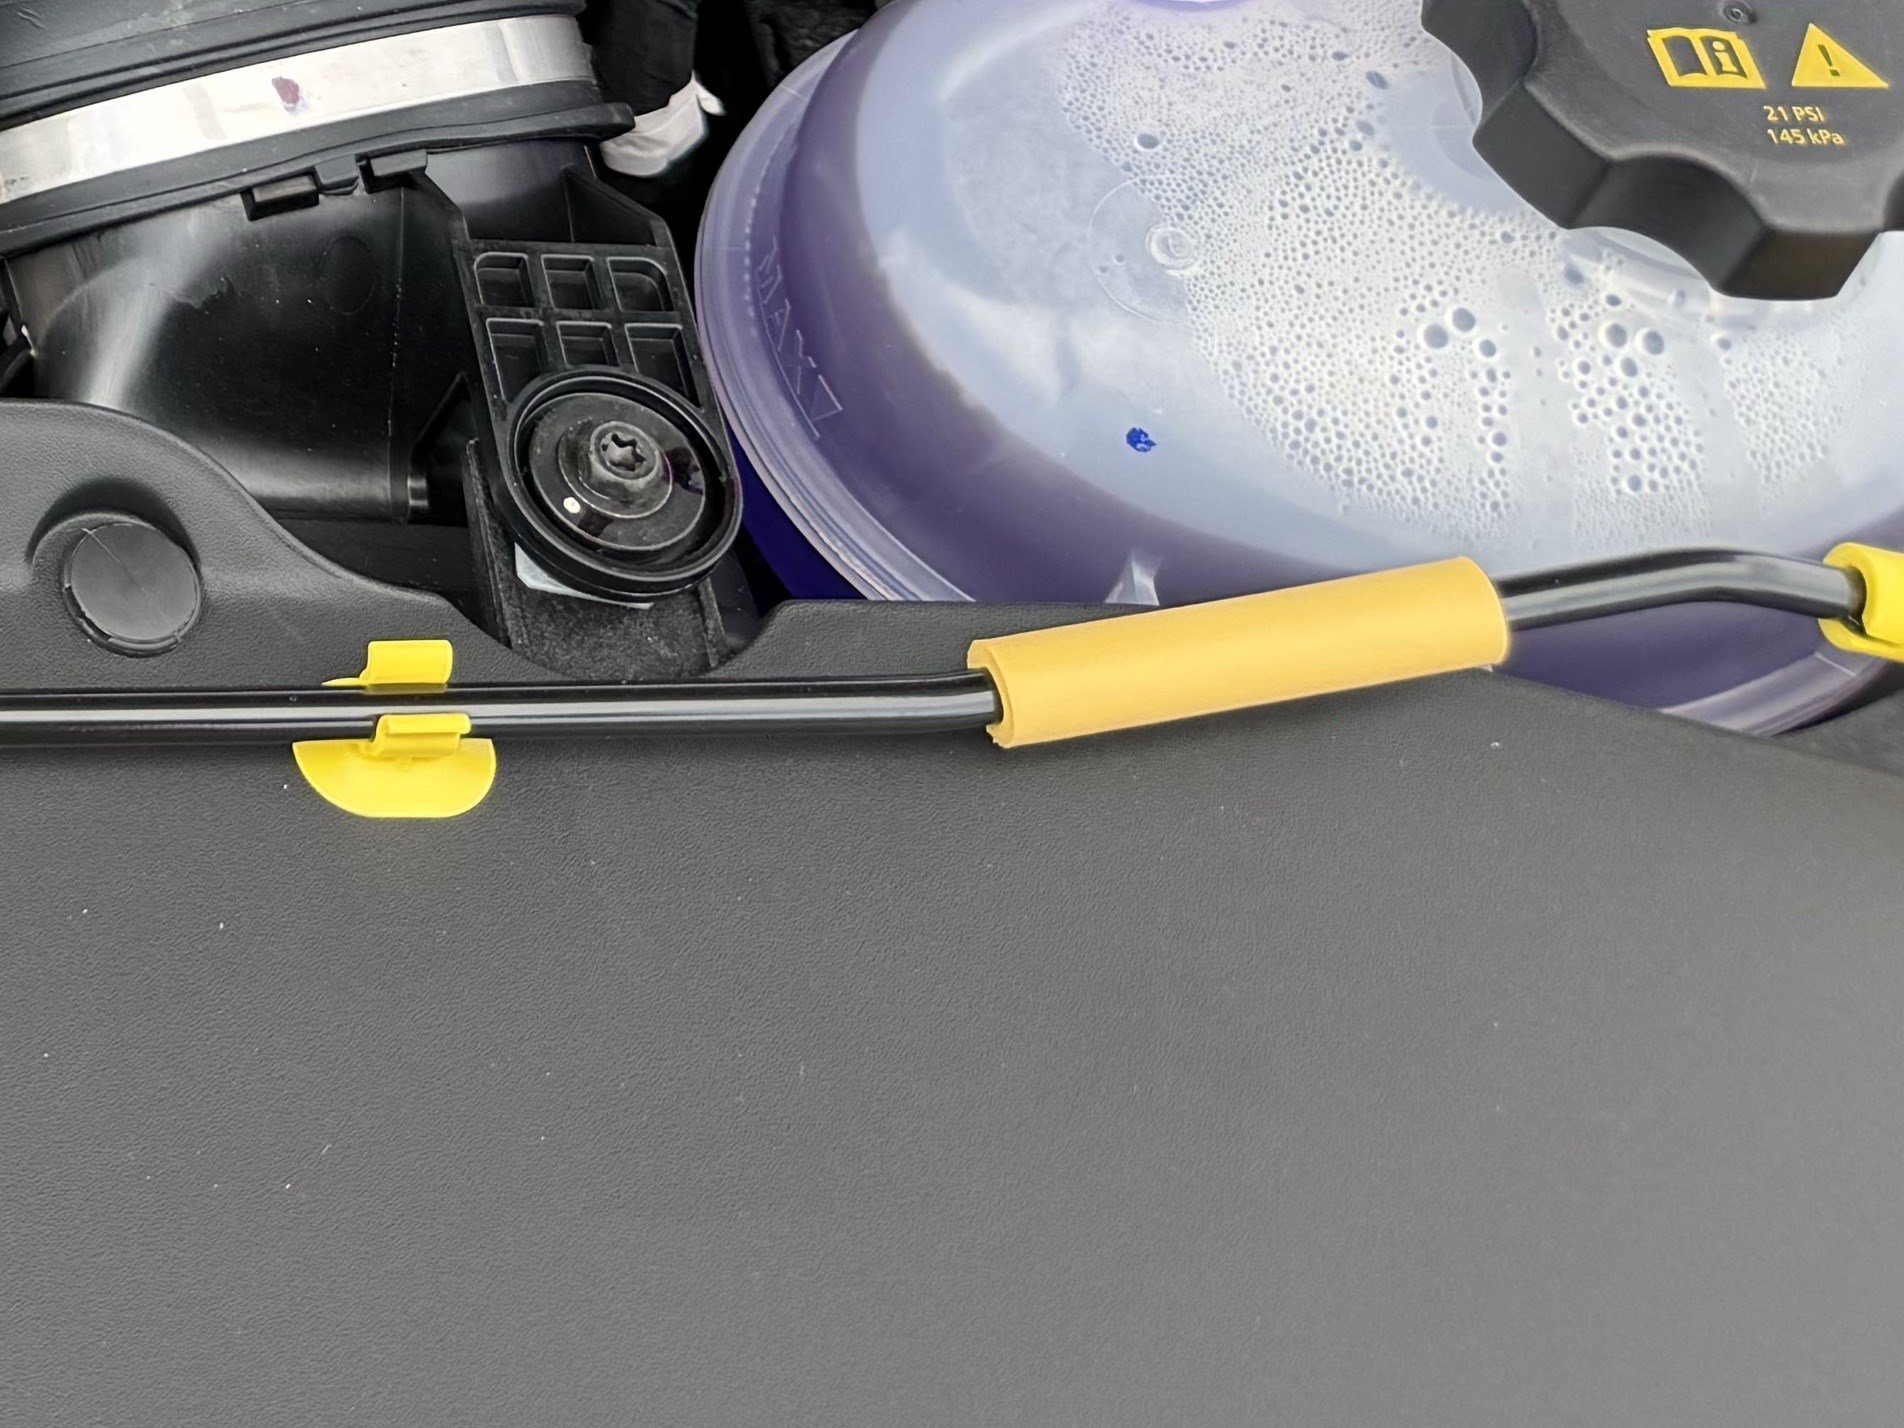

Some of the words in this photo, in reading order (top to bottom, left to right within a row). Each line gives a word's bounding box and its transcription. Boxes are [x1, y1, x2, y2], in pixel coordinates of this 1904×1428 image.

[1763, 105, 1787, 122] 21
[1790, 106, 1827, 122] PSI
[1767, 127, 1806, 145] 145
[1809, 128, 1846, 146] kPa
